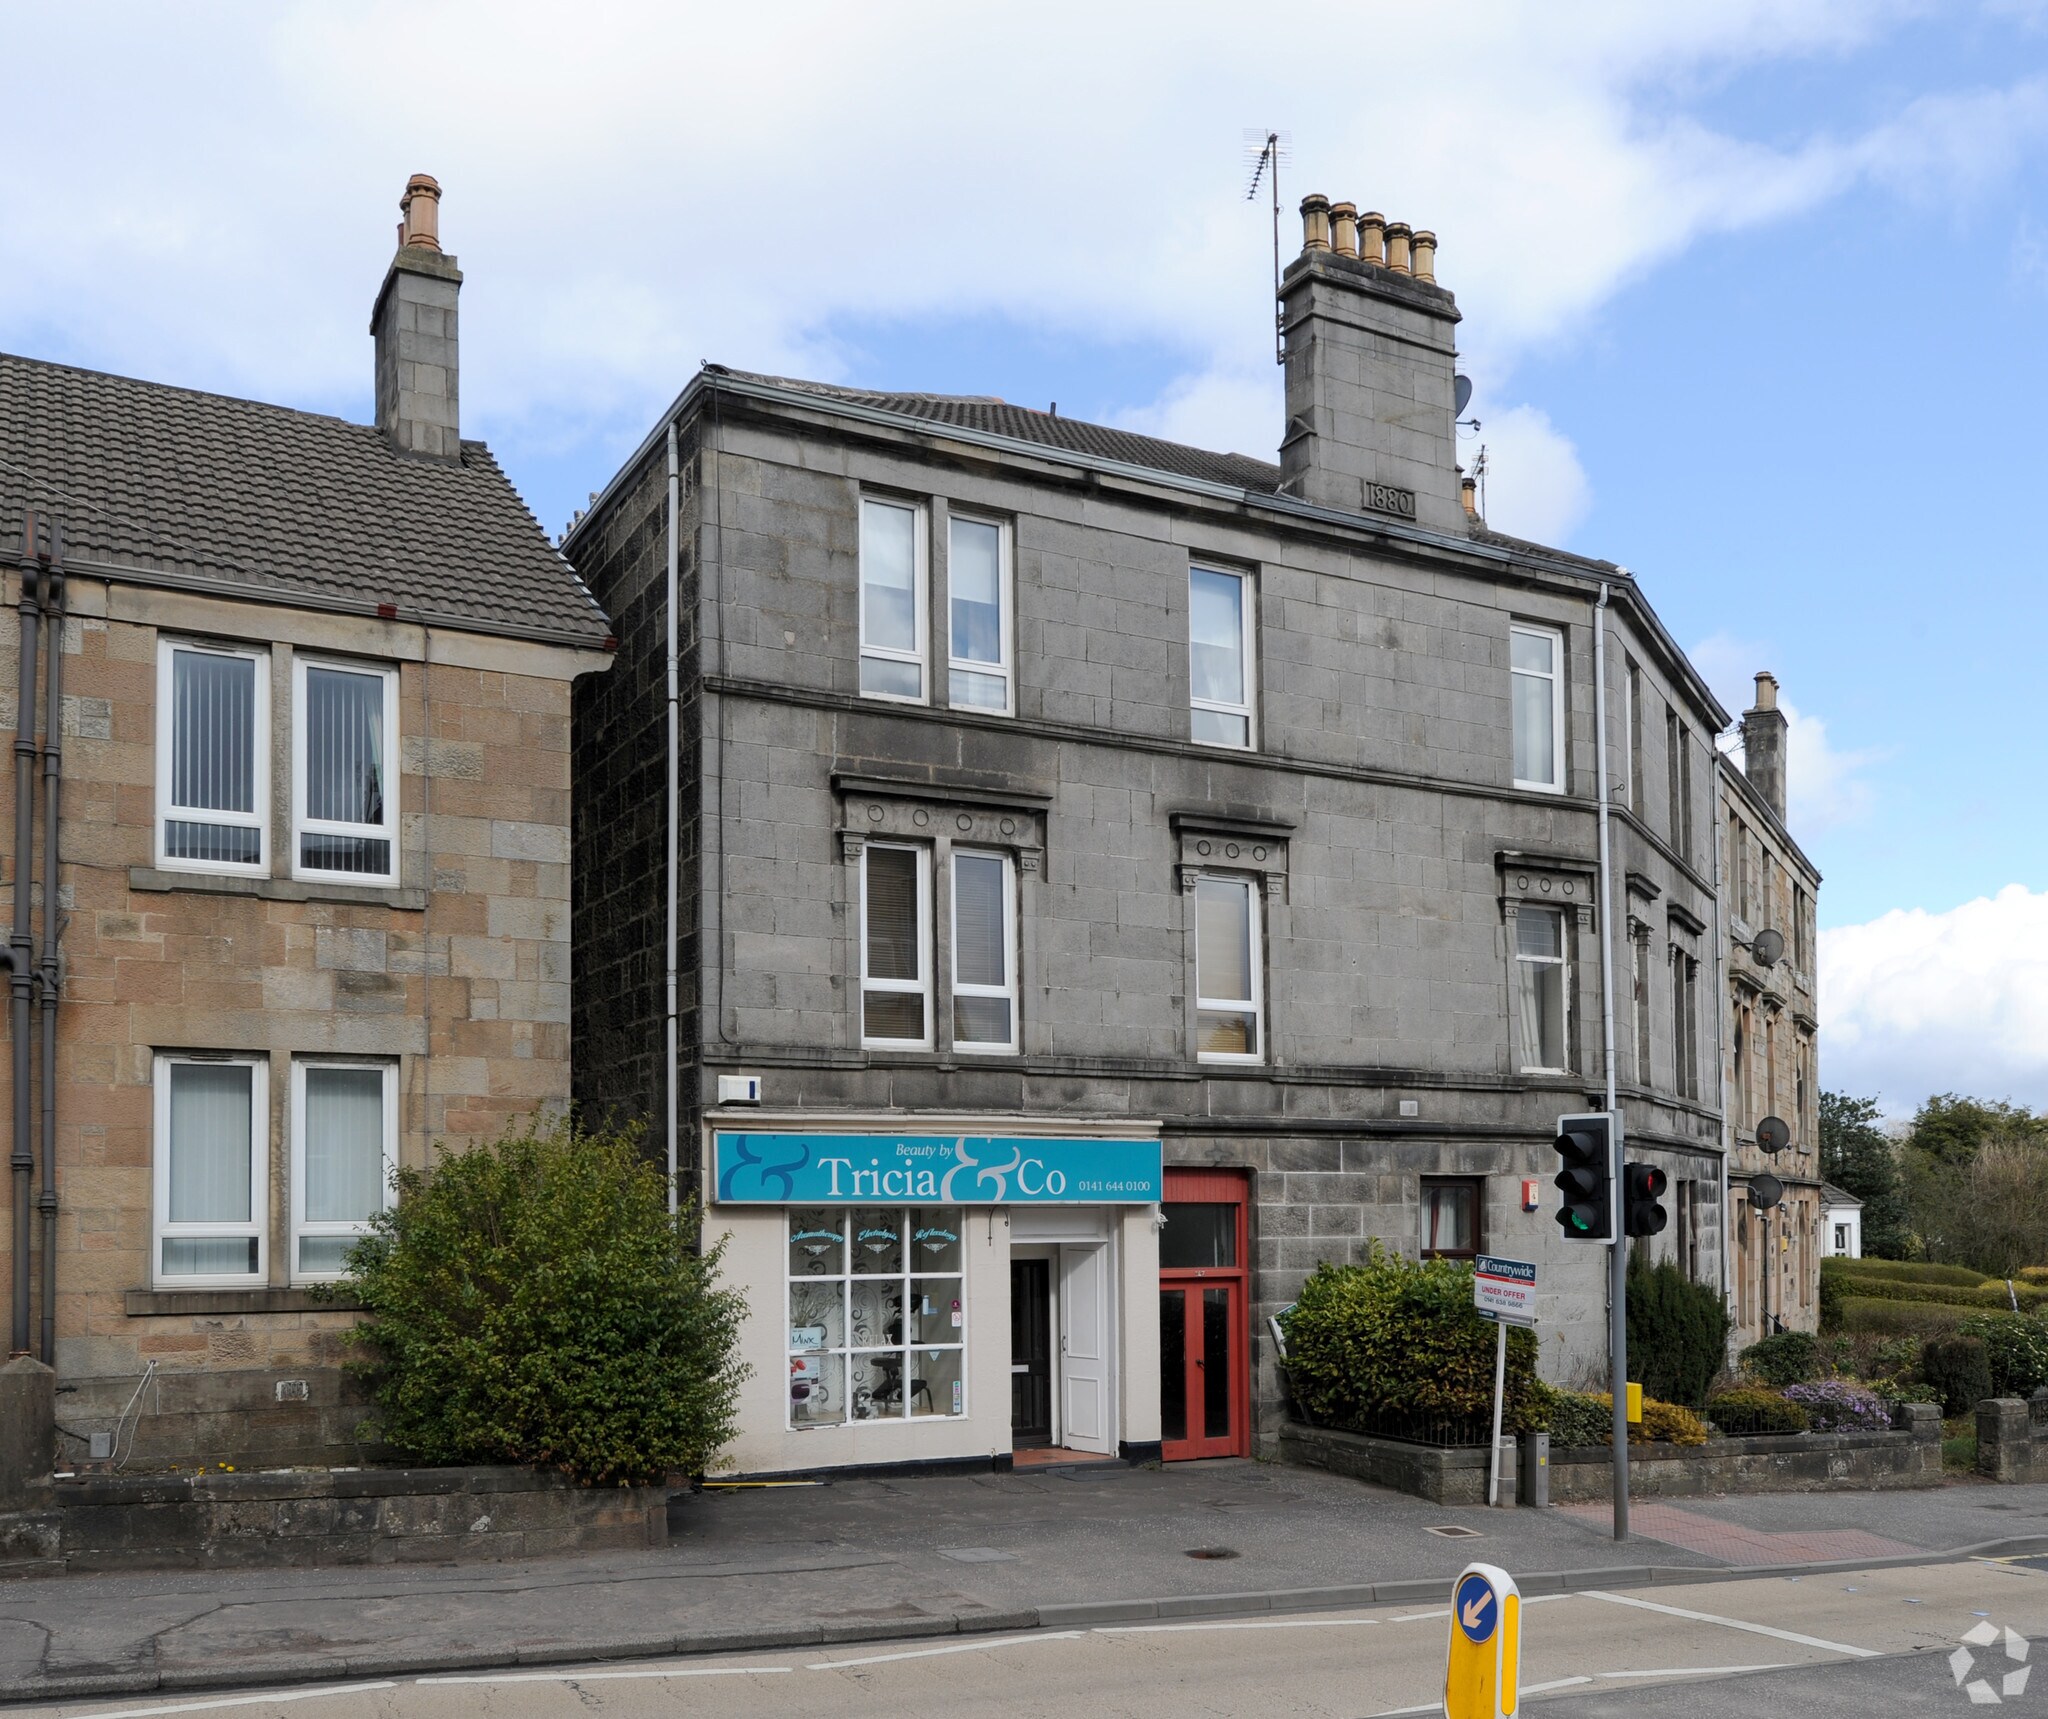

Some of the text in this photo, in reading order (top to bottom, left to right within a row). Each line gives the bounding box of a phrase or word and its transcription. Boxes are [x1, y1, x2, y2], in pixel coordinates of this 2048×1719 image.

[896, 1143, 953, 1159] Beauty by
[817, 1136, 1067, 1201] Tricia & Co
[1079, 1180, 1150, 1192] 0141 644 0100
[790, 1228, 844, 1243] Aromatherapy
[857, 1228, 899, 1242] Electrolysis
[913, 1228, 958, 1241] Reflexology
[1487, 1260, 1533, 1277] Countrywide
[1482, 1286, 1525, 1299] UNDER OFFER
[863, 1333, 894, 1346] RELAX
